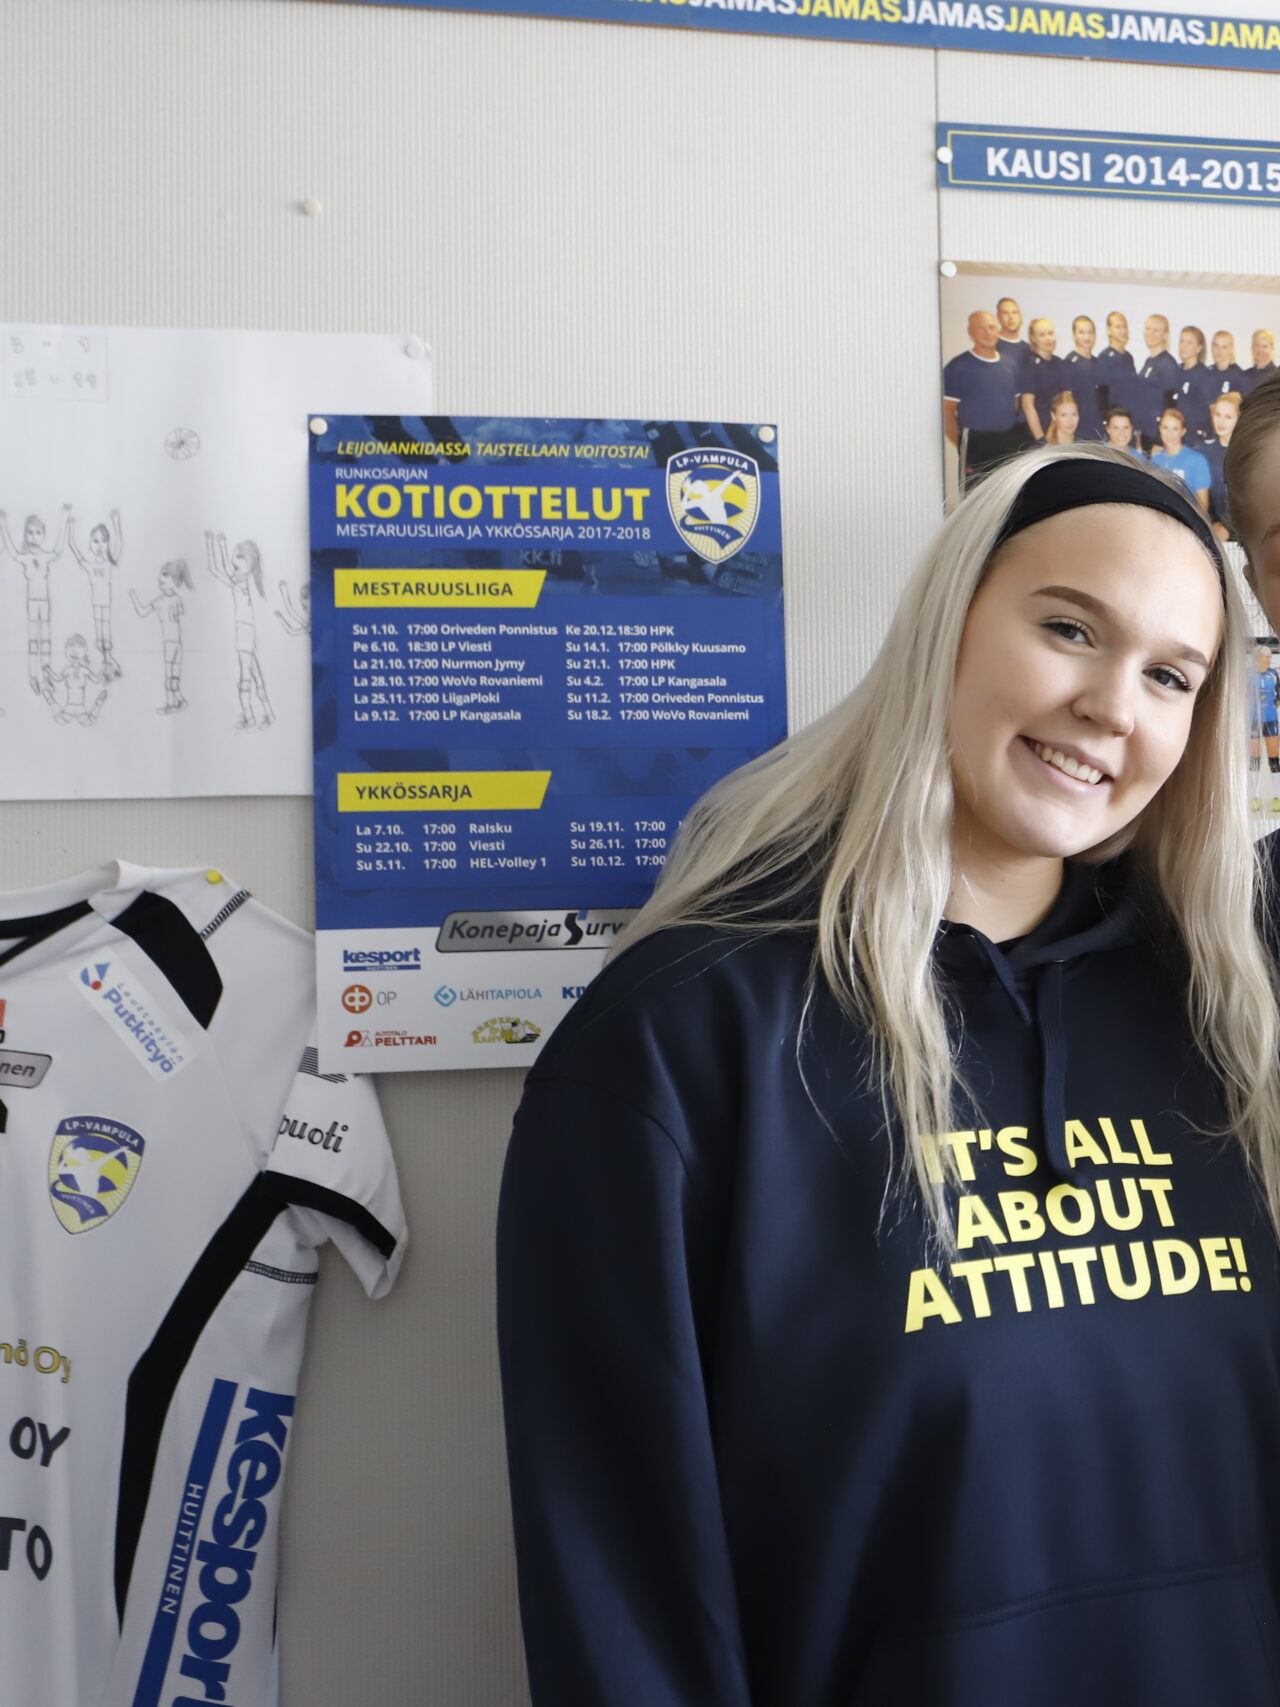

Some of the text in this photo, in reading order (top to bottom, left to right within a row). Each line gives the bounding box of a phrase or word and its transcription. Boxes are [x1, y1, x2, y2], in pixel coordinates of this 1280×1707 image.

[901, 0, 1004, 30] JAMAS
[1004, 6, 1105, 40] JAMAS
[1105, 13, 1205, 45] JAMAS
[986, 146, 1091, 182] KAUSI
[337, 441, 650, 459] LEIJONANKIDASSA TAISTELLAAN VOITOSTA!
[676, 455, 748, 470] LP-VAMPULA
[335, 467, 428, 481] RUNKOSARJAN
[335, 484, 650, 521] KOTIOTTELUT
[336, 523, 651, 541] MESTARUUSLIIGA JA YKKÖSSARJA 2017-2018
[353, 582, 513, 596] MESTARUUSLIIGA
[353, 624, 558, 635] Su 1.10. 17:00 Oriveden Ponnistus
[566, 625, 674, 636] Ke 20.12. 18:30 HPK
[353, 641, 491, 652] Pe 6.10. 18:30 LP Viesti
[566, 642, 746, 655] Su 14.1. 17:00 Pölkky Kuusamo
[354, 659, 525, 672] La 21.10. 17:00 Nurmon Jymy
[566, 659, 675, 670] Su 21.1. 17:00 HPK
[354, 676, 543, 687] La 28.10. 17:00 WoVo Rovaniemi
[567, 676, 726, 689] Su 4.2. 17:00 LP Kangasala
[354, 693, 500, 706] La 25.11. 17:00 LiigaPloki
[567, 693, 764, 704] Su 11.2. 17:00 Oriveden Ponnistus
[355, 710, 521, 723] La 9.12. 17:00 LP Kangasala
[568, 710, 749, 720] Su 18.2. 17:00 WoVo Rovaniemi
[356, 782, 472, 802] YKKÖSSARJA
[356, 825, 371, 835] La
[374, 824, 404, 835] 7.10.
[423, 824, 456, 834] 17:00
[356, 840, 505, 853] Su 22.10. 17:00 Viesti
[357, 857, 546, 871] Su 5.11. 17:00 HEL-Volley 1
[449, 918, 561, 943] Konepaja
[343, 948, 421, 965] kesport
[377, 992, 397, 1006] OP
[460, 987, 543, 1001] LÄHITAPIOLA
[102, 987, 176, 1073] Putkityö
[375, 1035, 437, 1047] PELTTARI
[65, 1120, 139, 1147] LP-VAMPULA
[1064, 1117, 1174, 1168] ALL
[957, 1178, 1175, 1250] ABOUT
[904, 1237, 1252, 1333] ATTITUDE!
[9, 1416, 71, 1468] OY
[161, 1481, 204, 1615] HUITTINEN
